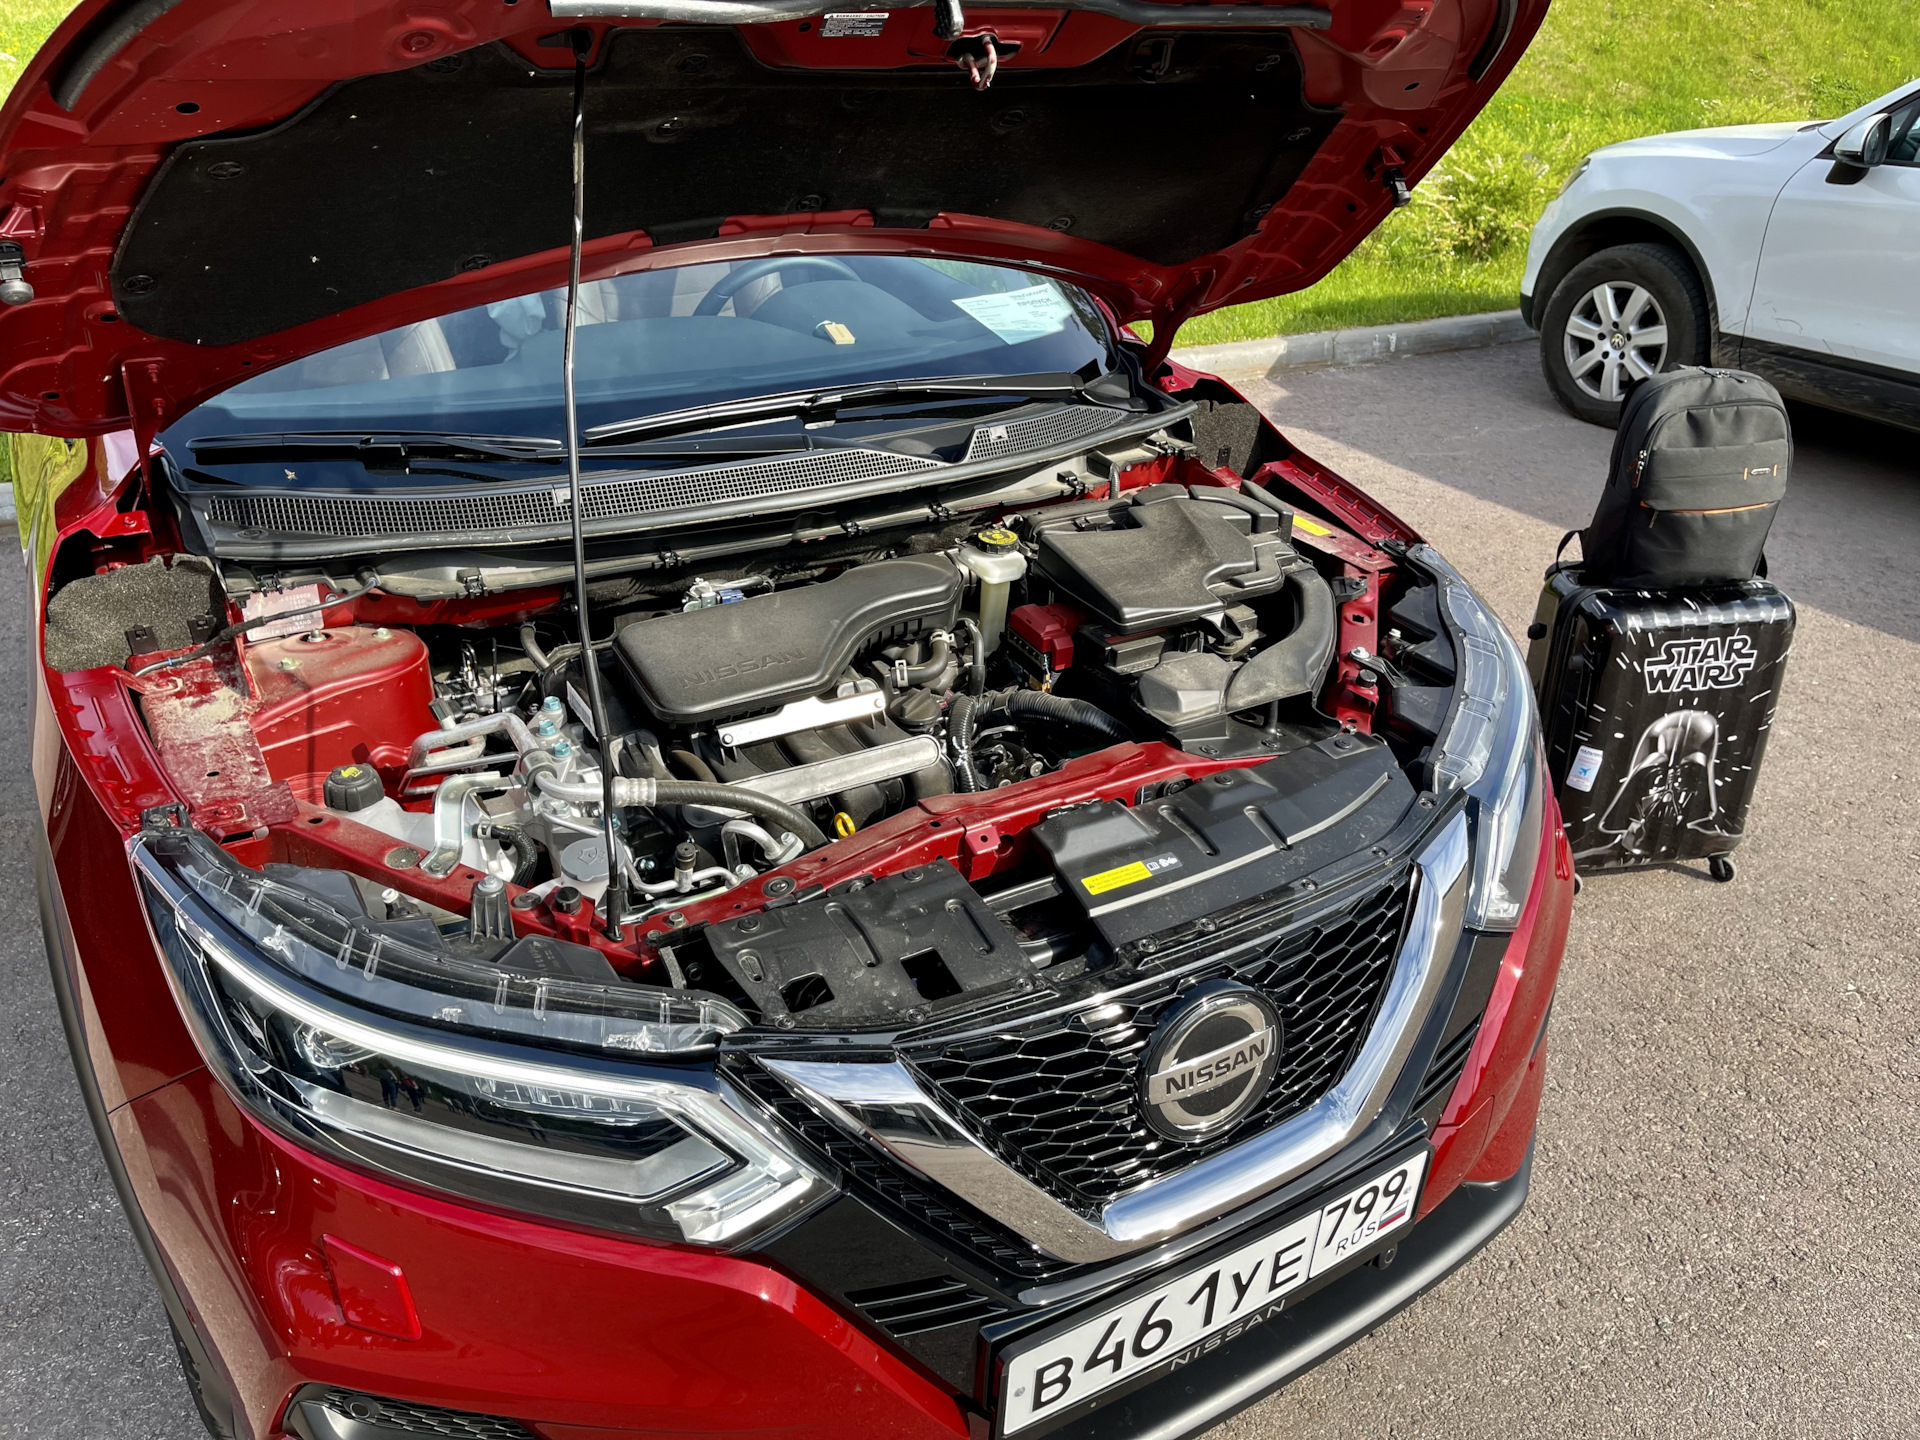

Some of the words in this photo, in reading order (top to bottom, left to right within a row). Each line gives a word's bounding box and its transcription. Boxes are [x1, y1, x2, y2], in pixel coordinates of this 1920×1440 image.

[680, 648, 807, 689] NISSAN
[1644, 635, 1758, 669] STAR
[1644, 660, 1755, 694] WARS
[1165, 1038, 1265, 1096] NISSAN
[1324, 1168, 1408, 1249] 799
[1336, 1221, 1377, 1256] RUS
[1171, 1299, 1286, 1371] NISSAN
